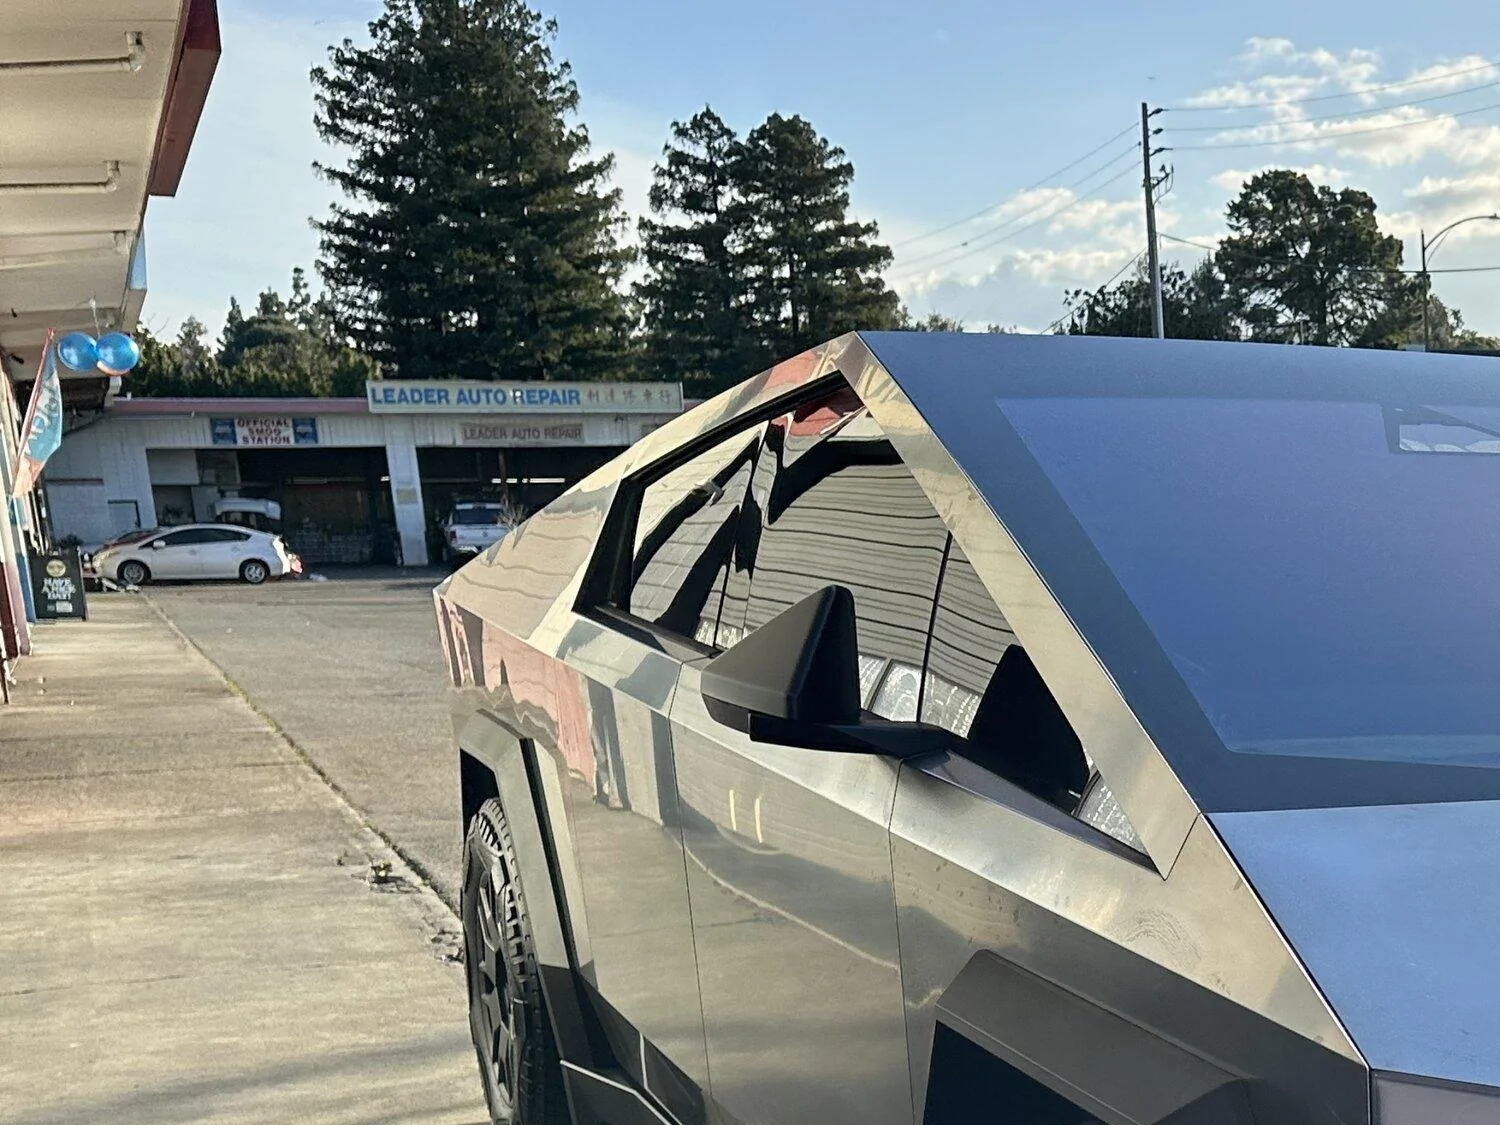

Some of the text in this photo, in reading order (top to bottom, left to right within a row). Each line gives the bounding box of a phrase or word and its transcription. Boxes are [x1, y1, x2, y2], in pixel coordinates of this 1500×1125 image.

[371, 388, 581, 405] LEADER AUTO REPAIR
[463, 426, 581, 440] LEADER AUTO REPAIR
[242, 436, 290, 445] STATION
